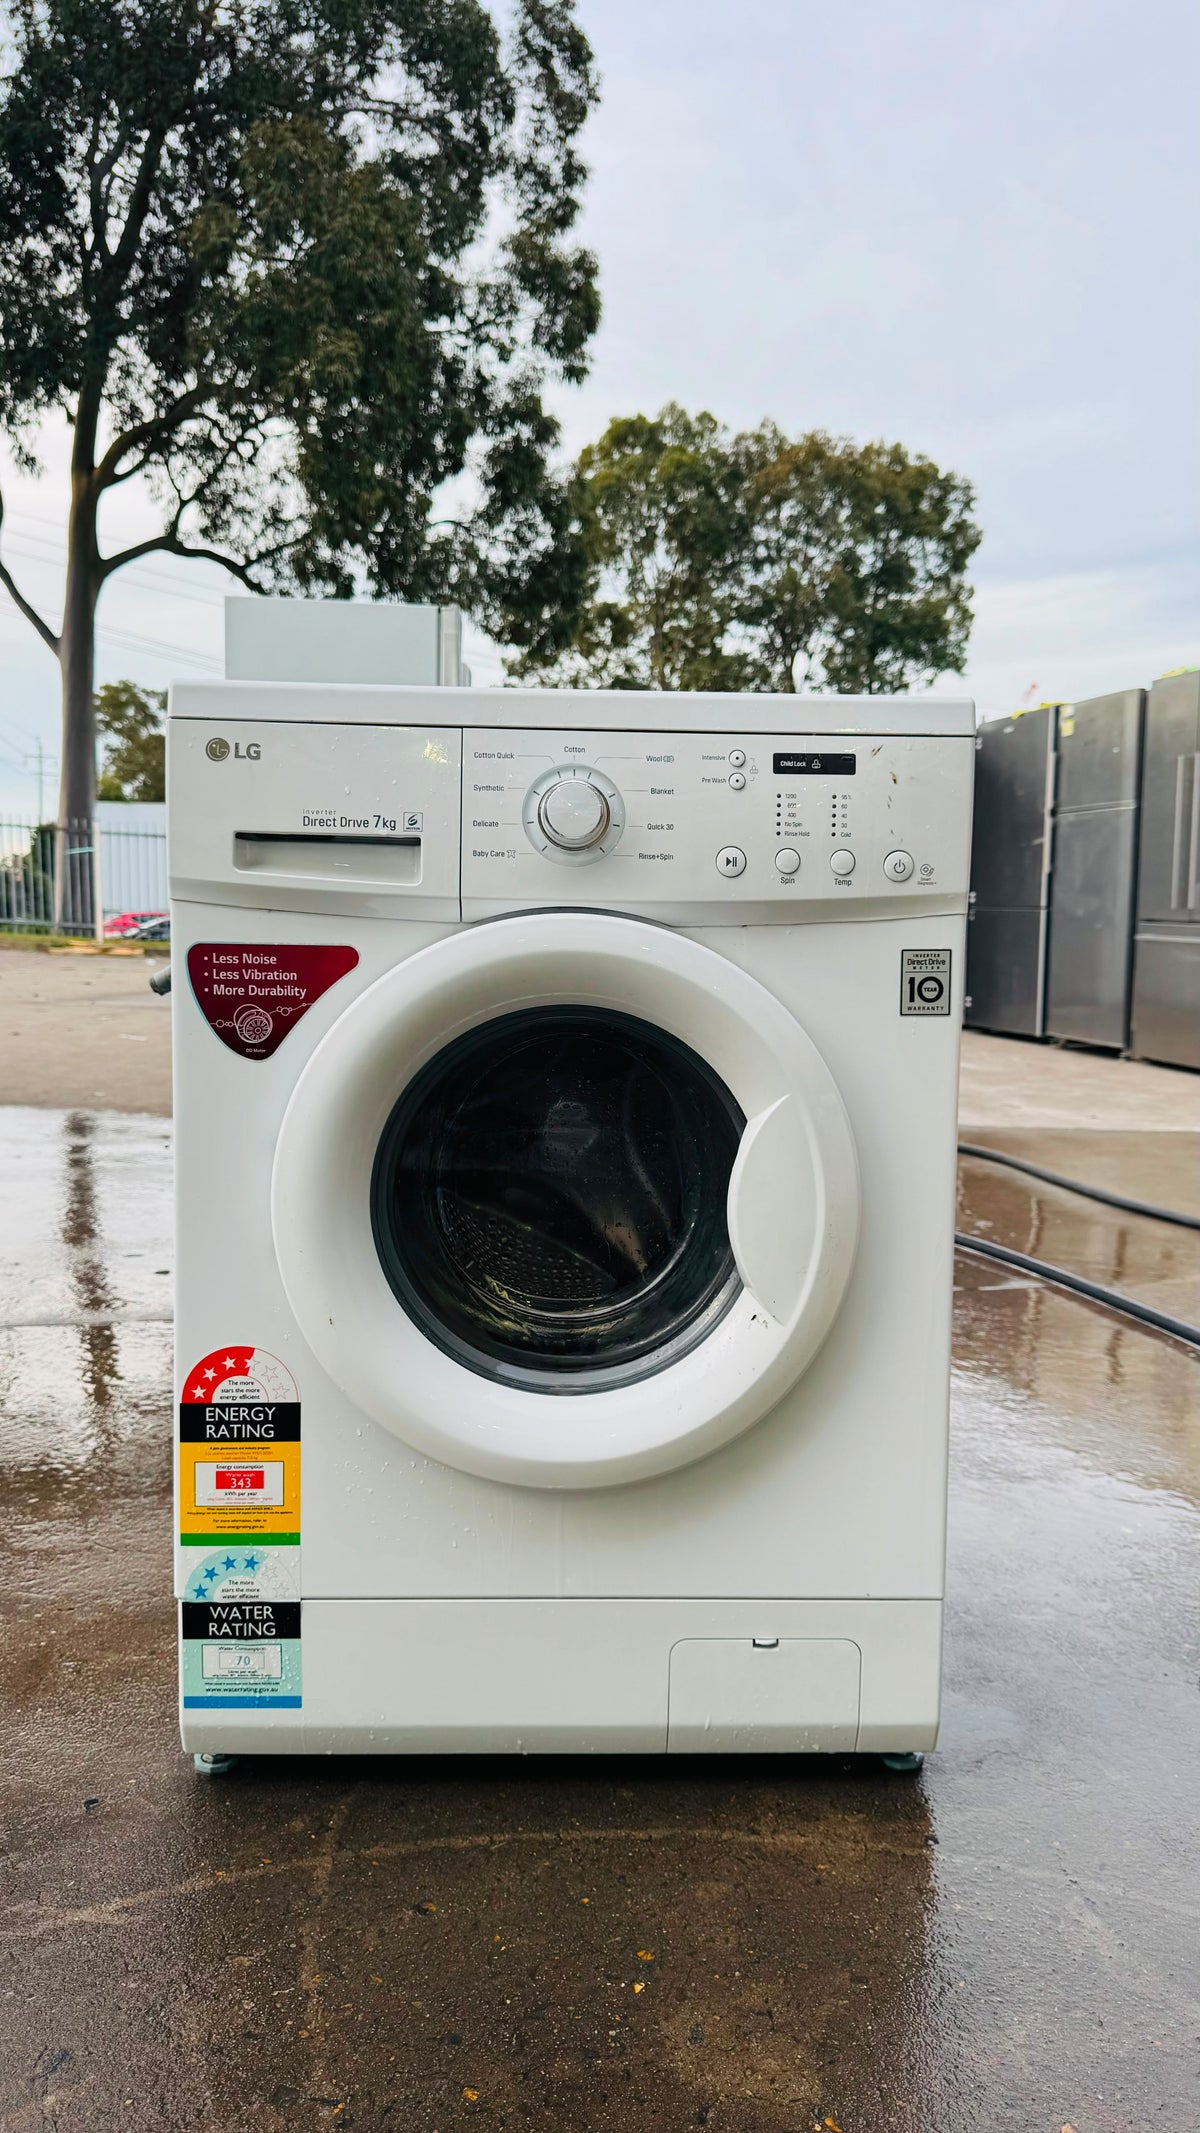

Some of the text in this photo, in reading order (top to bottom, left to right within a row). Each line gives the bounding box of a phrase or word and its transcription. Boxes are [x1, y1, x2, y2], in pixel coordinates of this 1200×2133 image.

[234, 743, 261, 760] LG
[497, 752, 515, 760] Quick
[303, 815, 396, 831] Direct Drive 7kg
[473, 850, 488, 858] Baby
[213, 953, 277, 964] Less Noise
[213, 968, 297, 980] Less Vibration
[213, 984, 306, 999] More Durability
[908, 976, 944, 1003] 10
[206, 1407, 276, 1421] ENERGY
[206, 1424, 274, 1438] RATING
[231, 1478, 251, 1488] 343
[210, 1606, 274, 1620] WATER
[208, 1622, 276, 1636] RATING
[236, 1656, 251, 1665] 70
